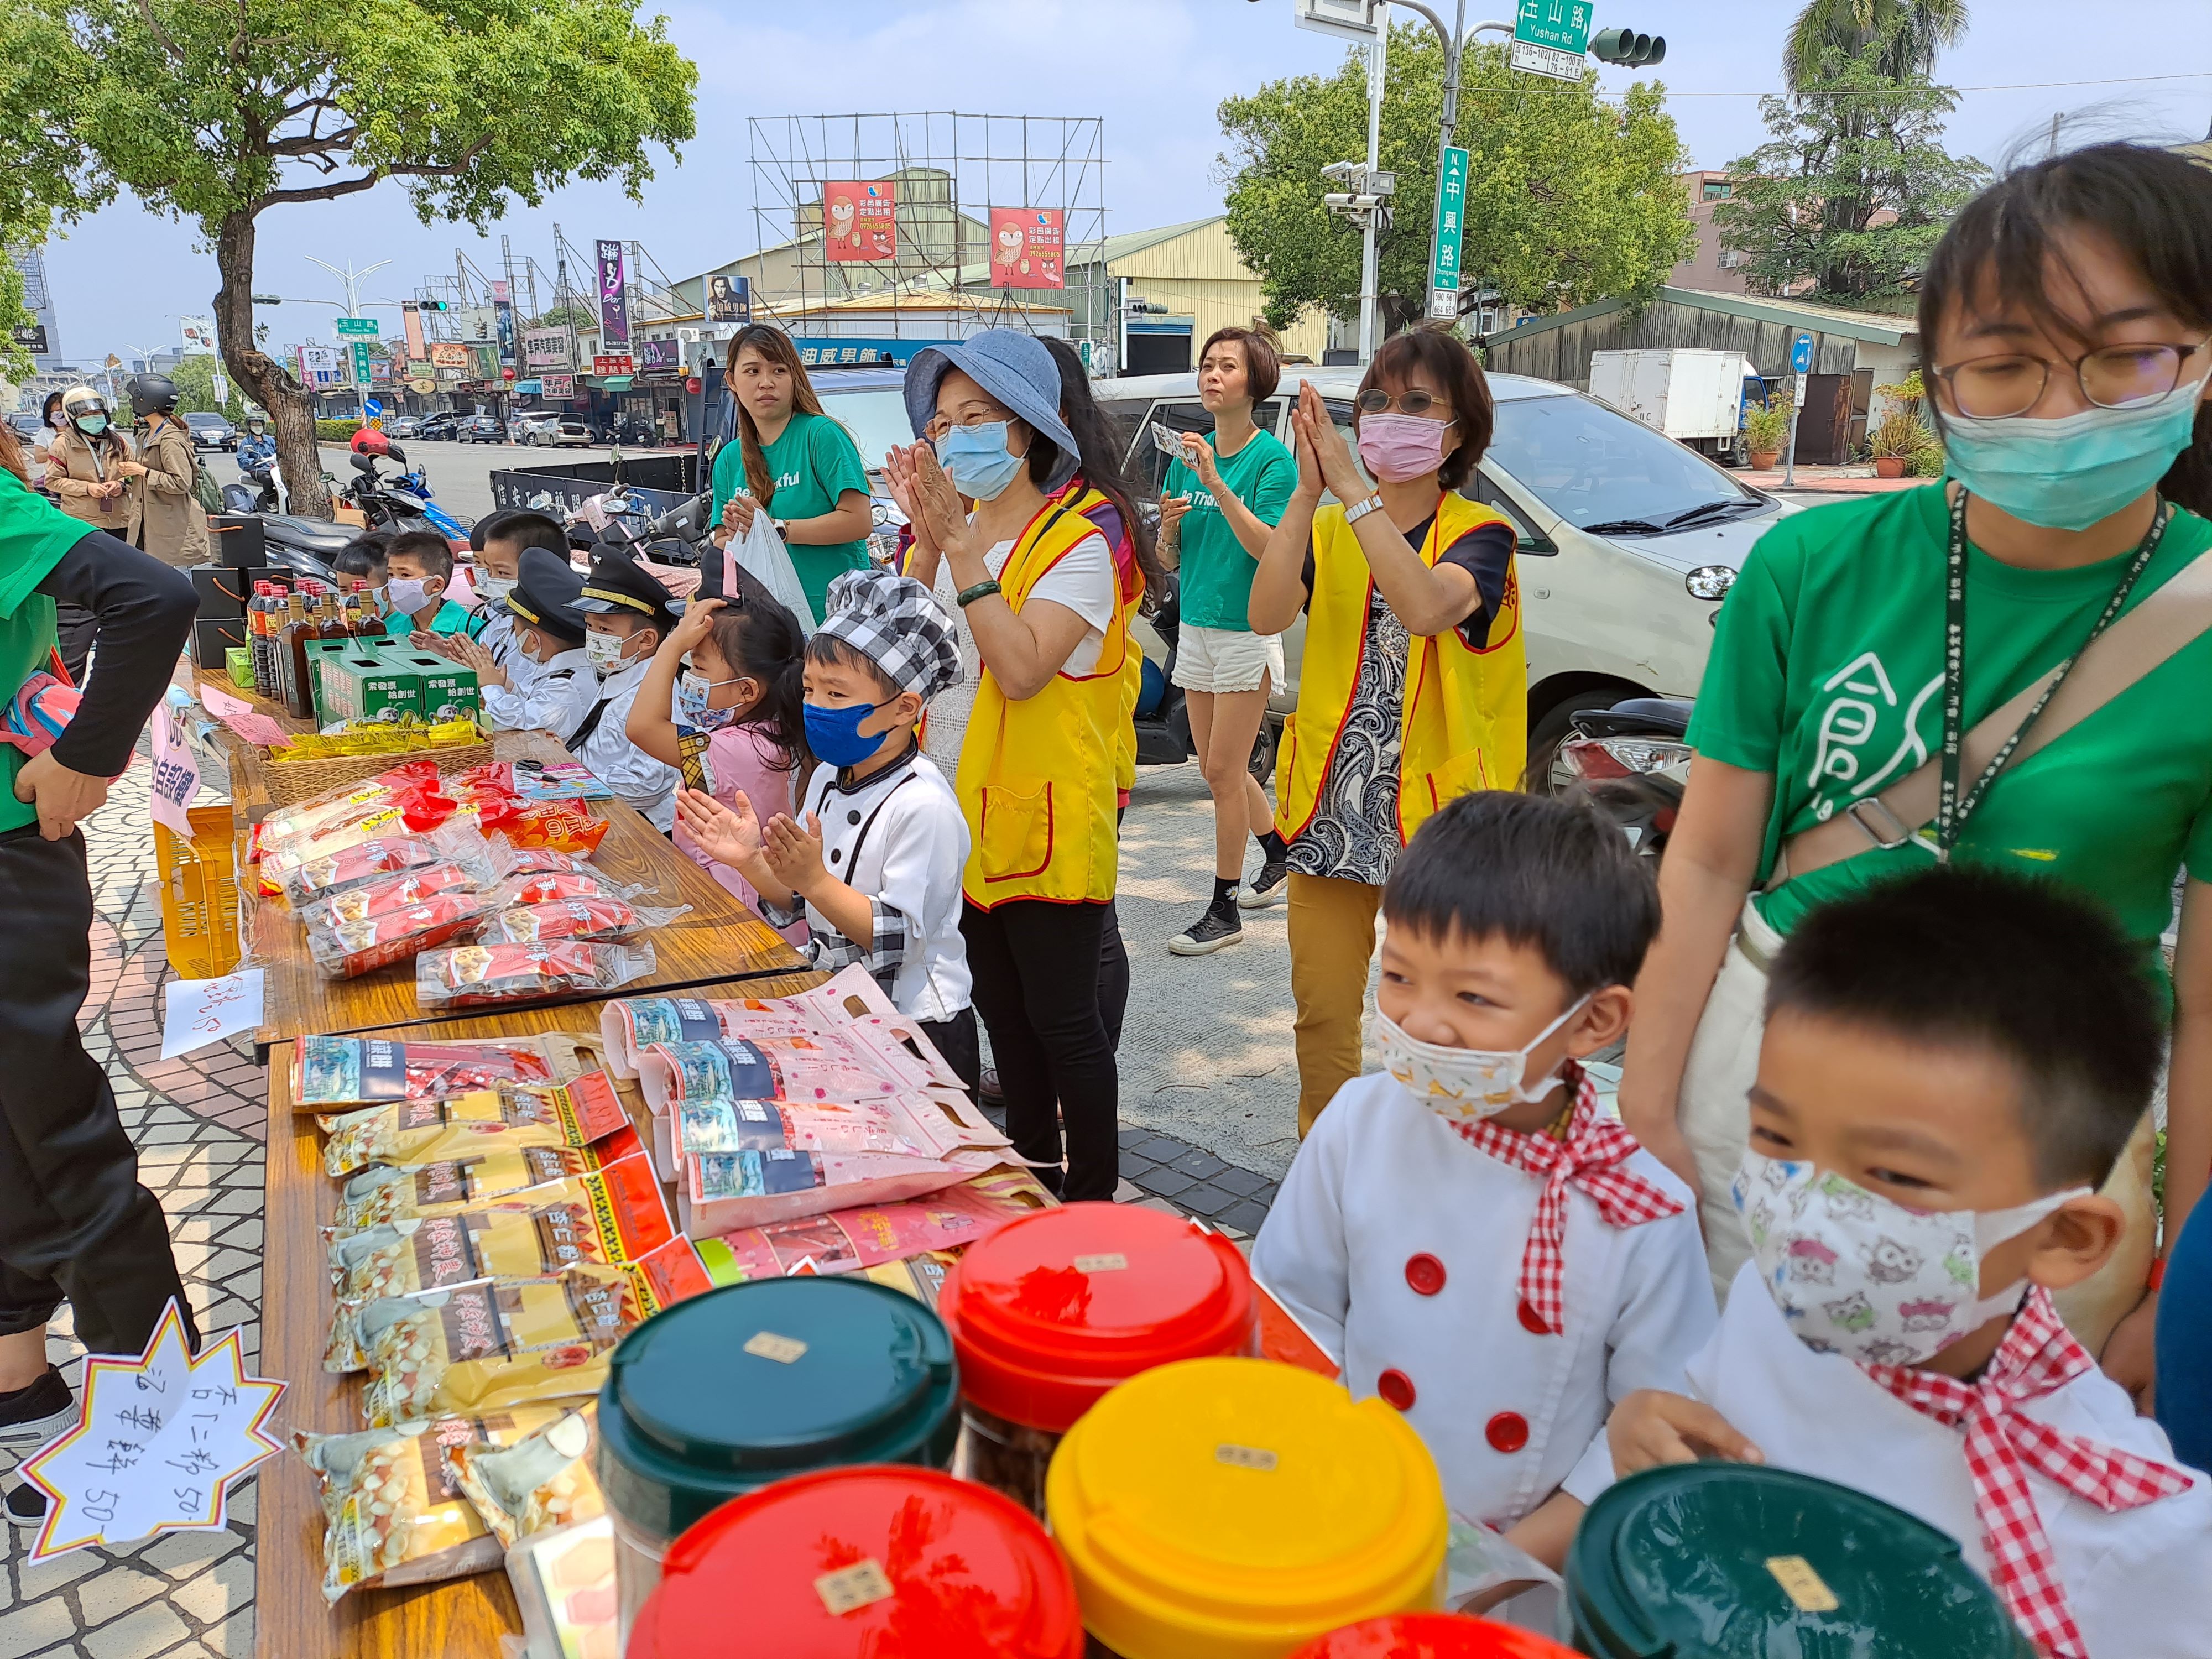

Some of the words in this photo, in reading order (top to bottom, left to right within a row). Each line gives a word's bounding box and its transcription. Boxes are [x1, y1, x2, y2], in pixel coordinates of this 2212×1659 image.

[1530, 24, 1559, 41] Yushan
[1562, 32, 1574, 45] Rd.
[1451, 153, 1459, 166] N.
[859, 208, 891, 216] 定點出租
[1441, 177, 1460, 267] 中興路
[1029, 236, 1060, 244] 定點出租
[1436, 268, 1457, 277] Zhongxing
[603, 293, 622, 304] Bar
[341, 319, 374, 327] 玉山路
[801, 347, 878, 364] 迪威男飾
[358, 351, 367, 377] 中興路
[596, 365, 632, 375] 雞腿飯
[368, 681, 397, 691] 索發票
[428, 679, 456, 689] 索發票
[388, 690, 416, 700] 給創世
[447, 687, 475, 697] 給創世
[547, 1211, 580, 1260] 杏仁粉
[584, 1290, 621, 1327] 杏仁粉
